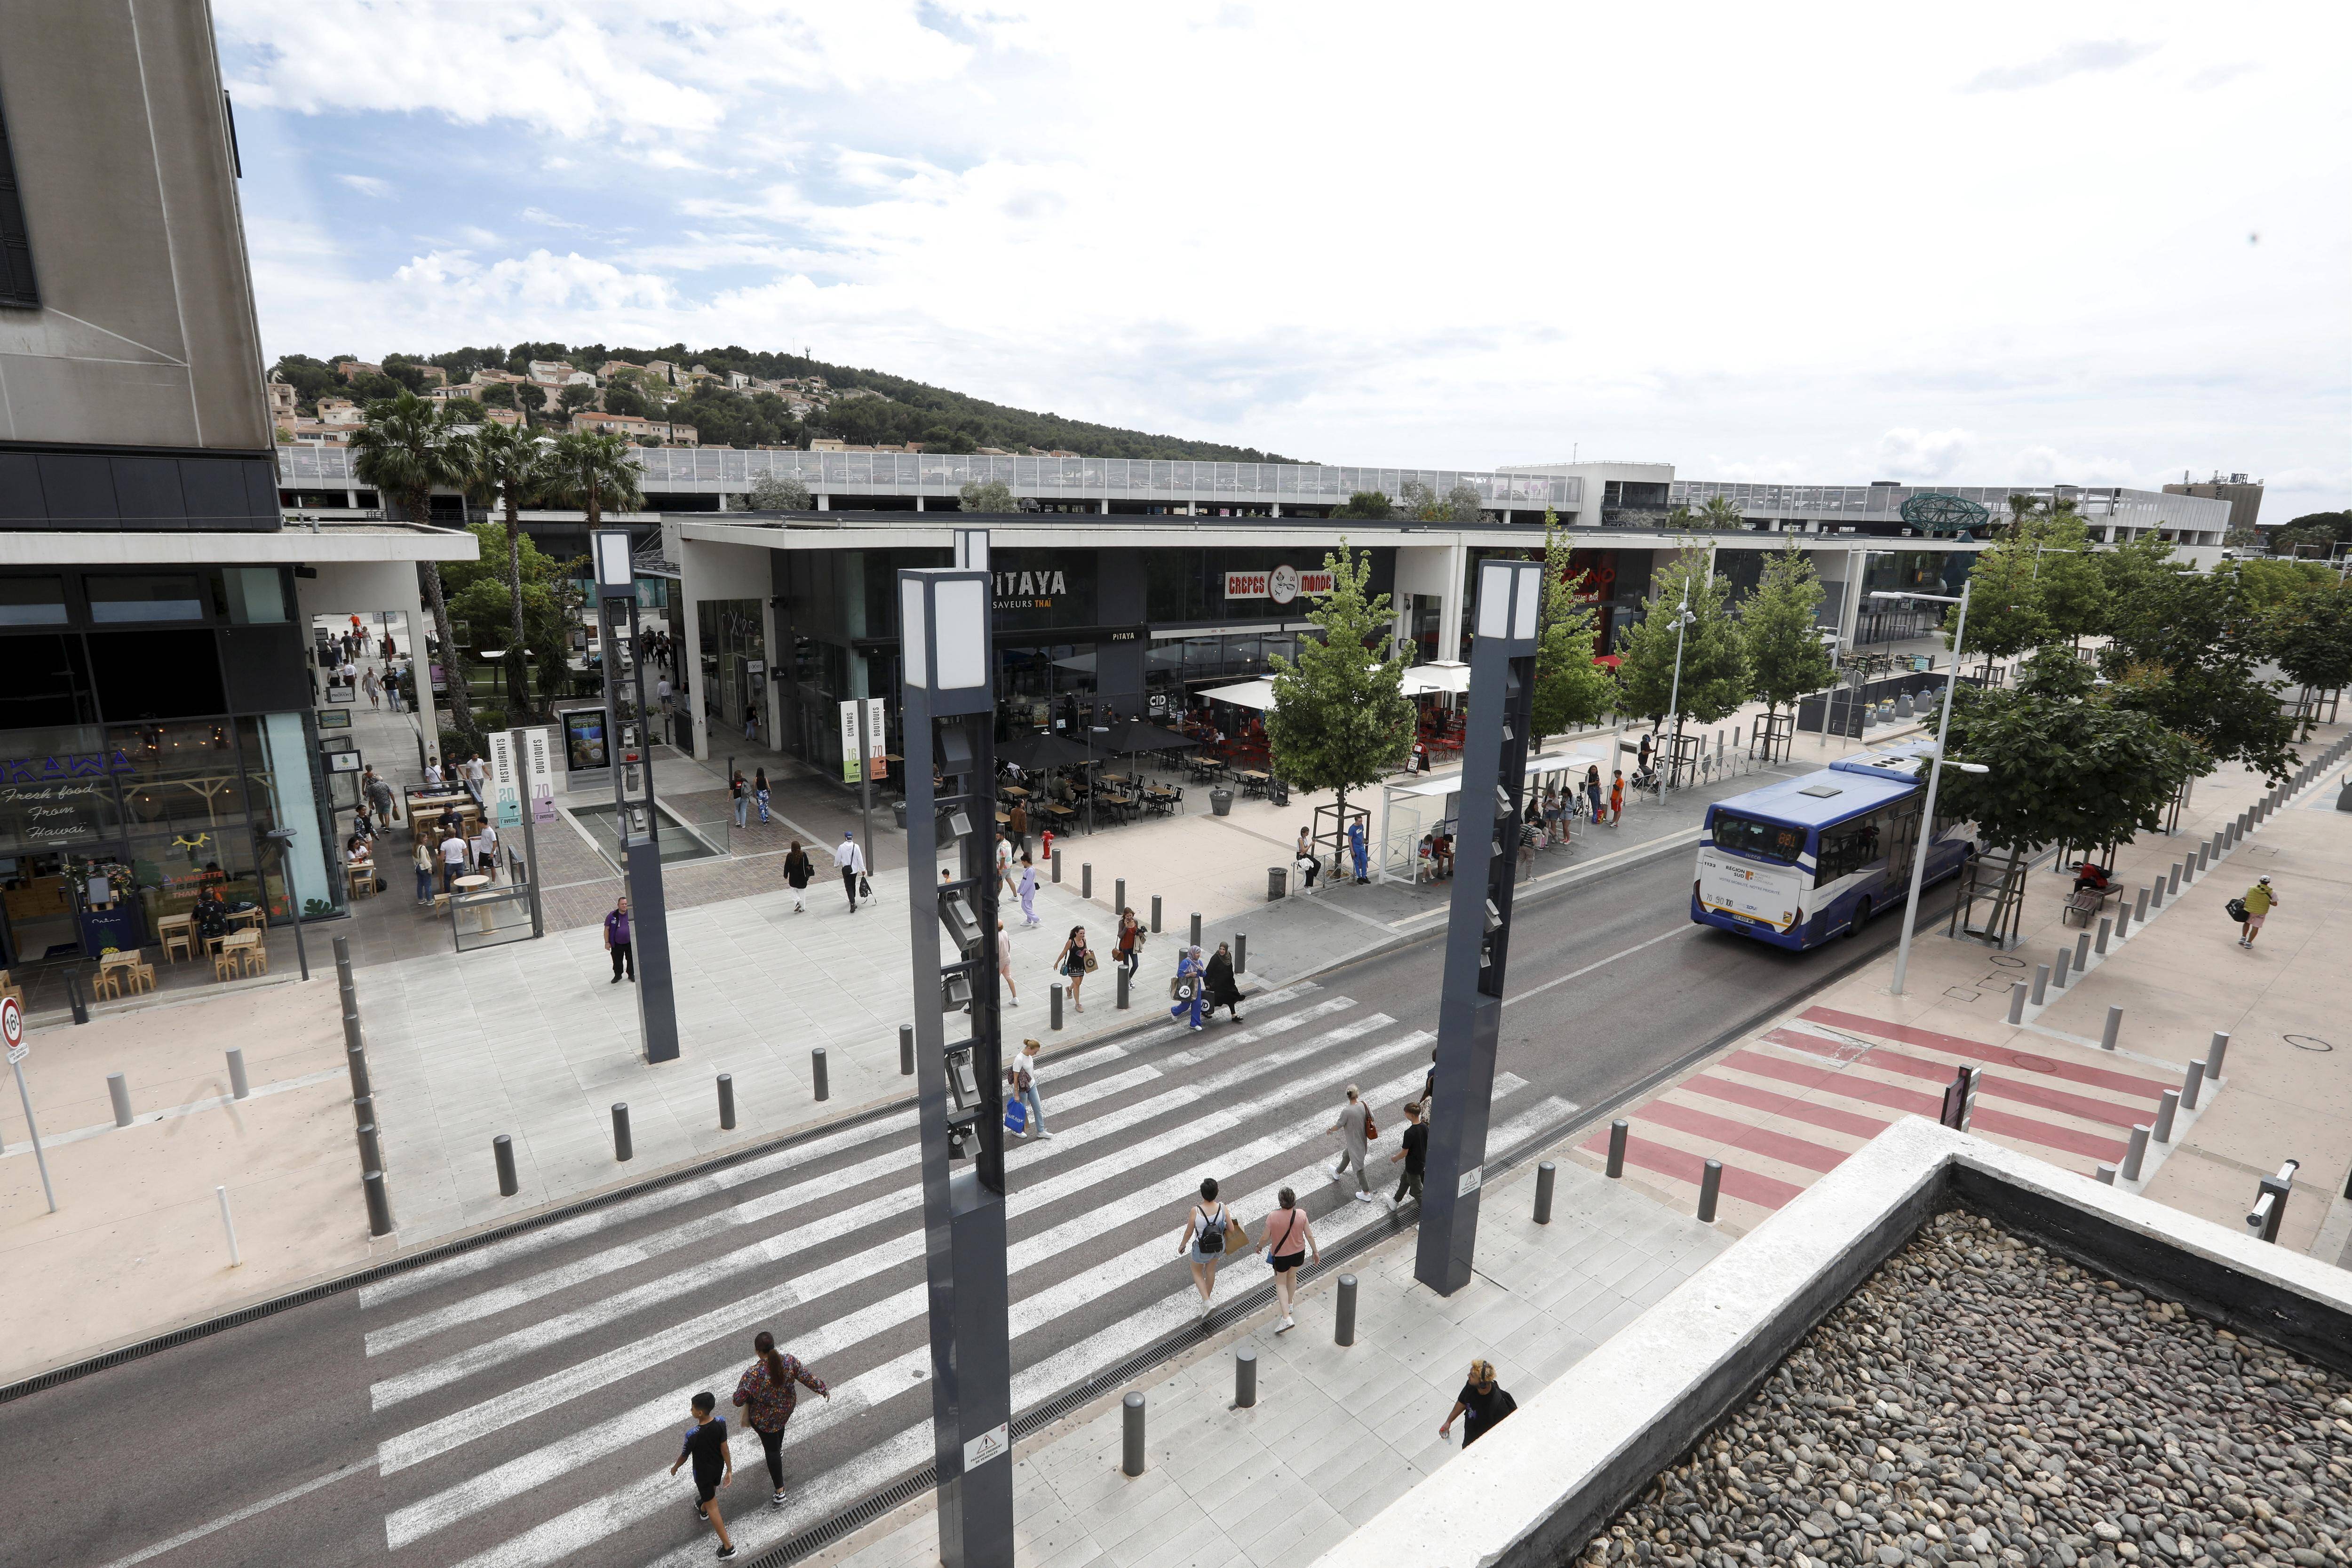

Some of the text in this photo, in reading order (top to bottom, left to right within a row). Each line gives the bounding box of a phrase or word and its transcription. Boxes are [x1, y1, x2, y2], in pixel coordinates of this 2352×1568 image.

[2230, 473, 2248, 484] HOTEL
[1229, 576, 1265, 594] CREPES
[1301, 575, 1331, 592] MONDE
[993, 597, 1051, 609] SAVEURS THAÏ
[846, 712, 854, 737] CINÉMAS
[533, 739, 545, 774] BOUTIQUES
[847, 748, 857, 761] 16
[873, 745, 883, 758] 70
[0, 750, 136, 785] KAWA
[496, 738, 509, 783] RESTAURANTS
[1, 783, 94, 802] Fresh food
[499, 788, 515, 802] 20
[535, 783, 550, 799] 70
[28, 806, 75, 820] From
[25, 822, 87, 838] Hawaï
[1778, 833, 1796, 847] 881
[184, 871, 223, 881] VALETTE
[172, 890, 198, 899] THAN
[1716, 896, 1724, 905] 90
[6, 1013, 19, 1035] 16t
[970, 1452, 985, 1463] PASSAGE
[981, 1450, 998, 1461] VEHICULES
